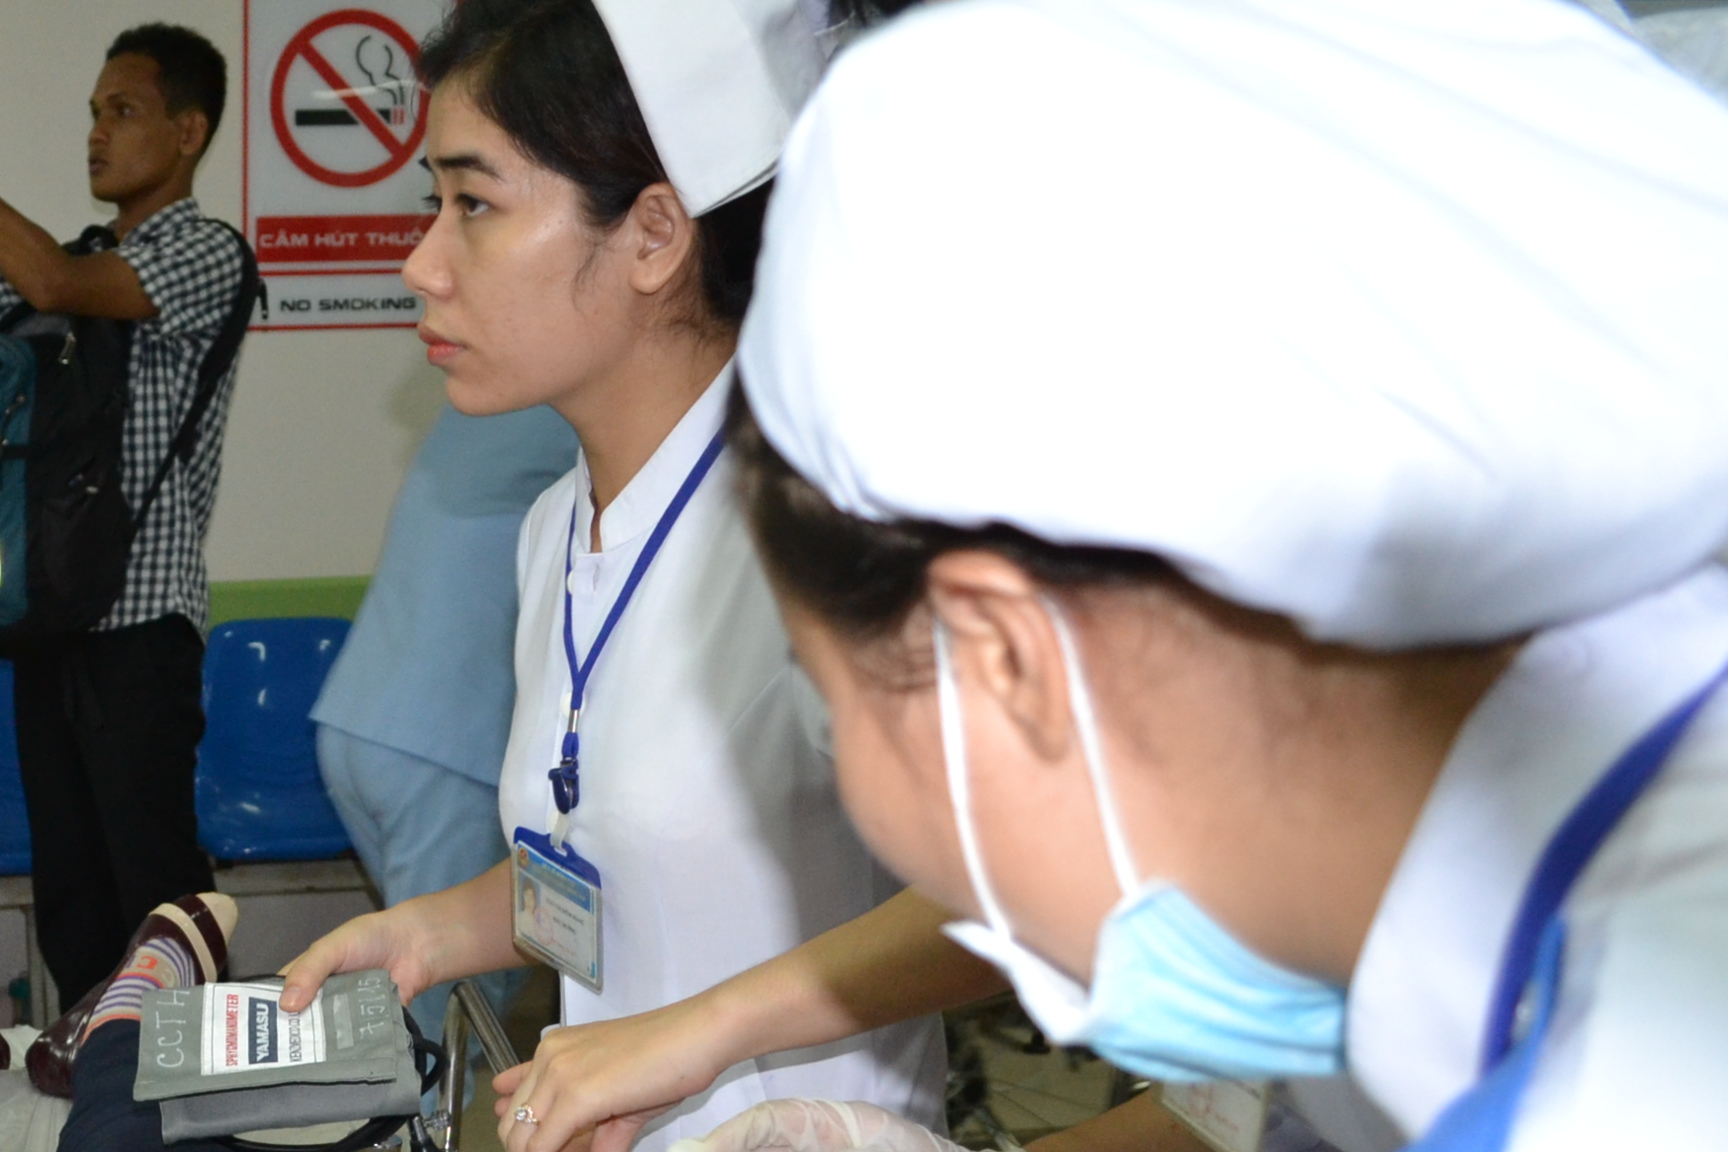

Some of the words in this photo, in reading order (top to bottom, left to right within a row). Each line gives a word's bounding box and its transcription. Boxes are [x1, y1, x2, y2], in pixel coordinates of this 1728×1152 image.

[280, 299, 312, 312] NO
[318, 296, 417, 311] SMOKING
[156, 988, 190, 1068] CCTH
[256, 1002, 270, 1062] YAMASU
